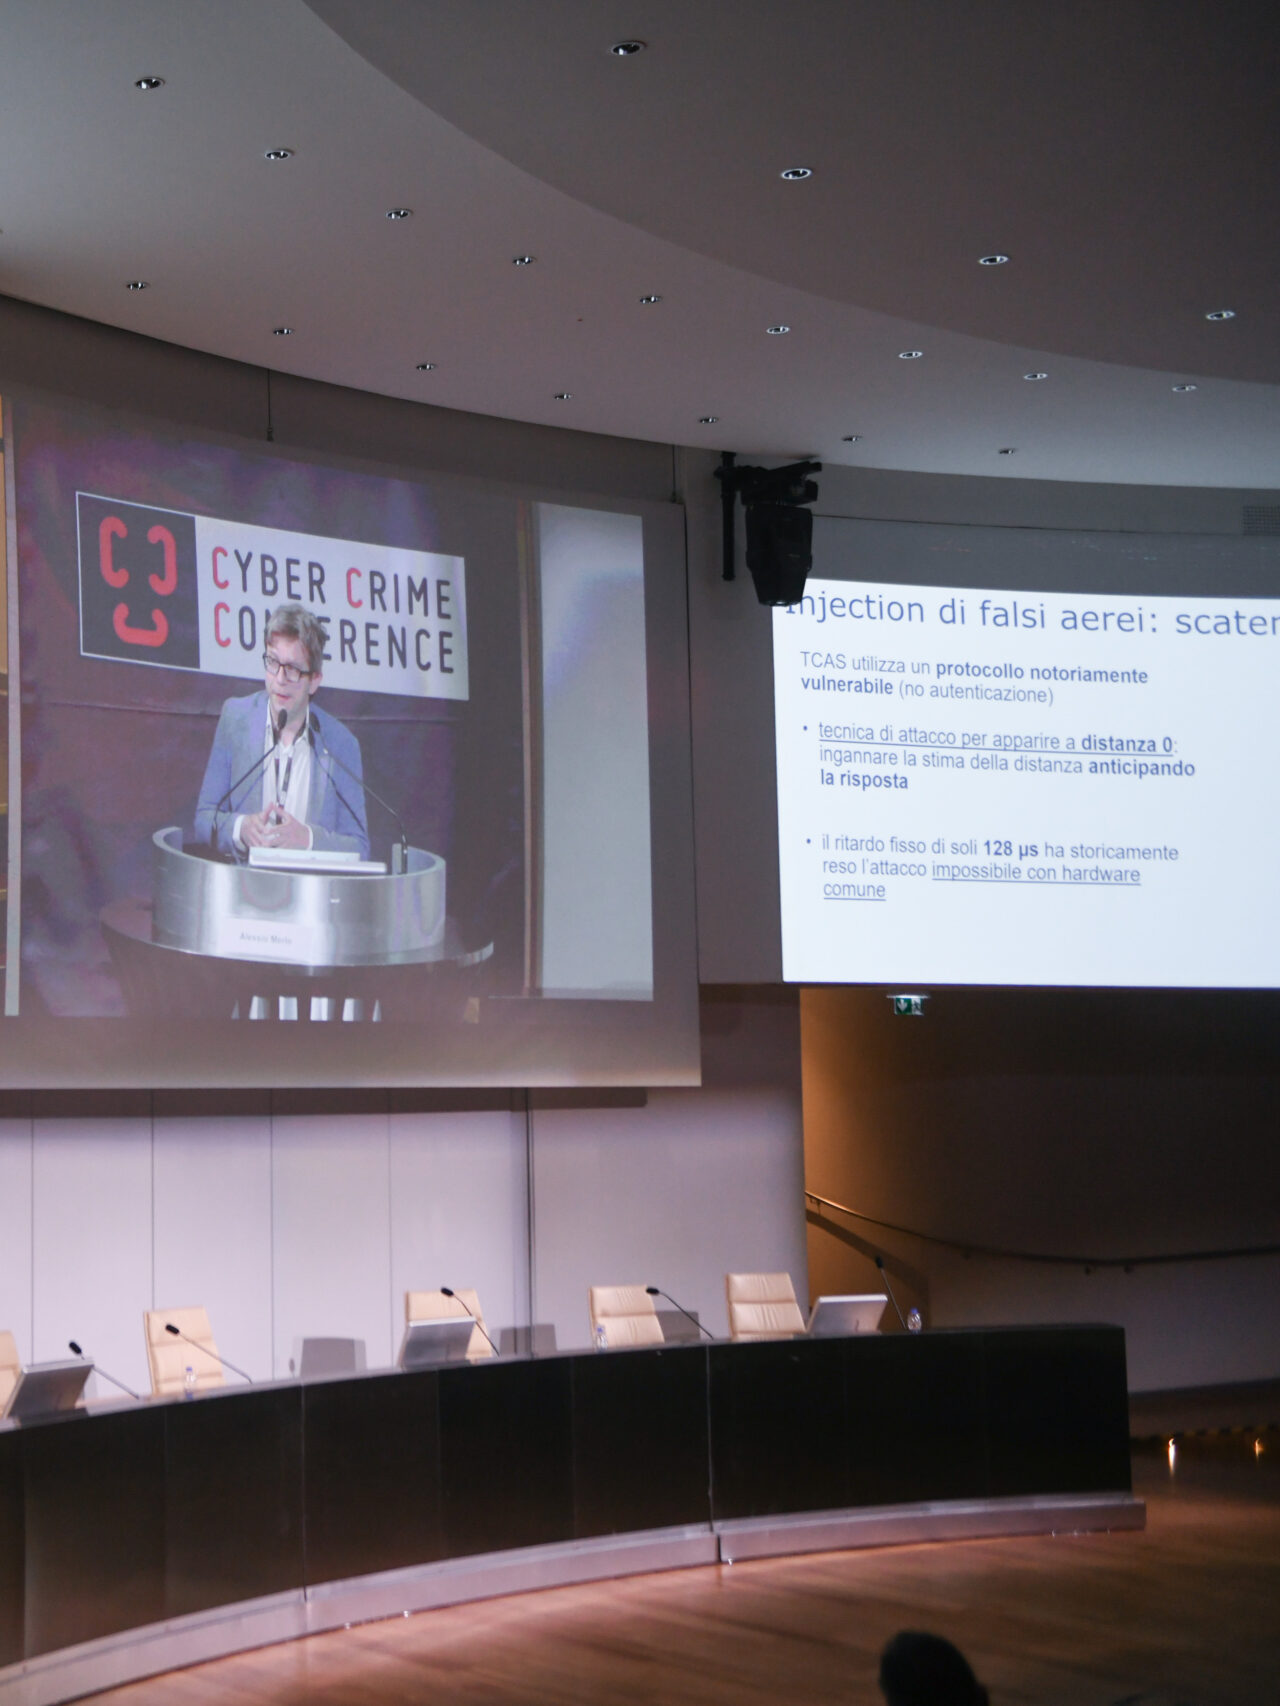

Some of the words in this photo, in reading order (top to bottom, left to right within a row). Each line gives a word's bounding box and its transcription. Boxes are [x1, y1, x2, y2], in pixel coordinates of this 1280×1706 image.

[212, 546, 326, 604] CYBER
[346, 567, 451, 620] CRIME
[939, 598, 965, 625] di
[980, 600, 1045, 628] falsi
[1061, 607, 1157, 633] aerei:
[800, 651, 847, 669] TCAS
[852, 656, 905, 673] utilizza
[911, 661, 930, 674] un
[936, 661, 1024, 679] protocollo
[1030, 666, 1148, 683] notoriamente
[801, 676, 893, 694] vulnerabile
[899, 680, 924, 699] (no
[930, 683, 1053, 706] autenticazione)
[819, 722, 874, 741] tecnica
[880, 725, 893, 741] di
[898, 728, 956, 745] attacco
[962, 730, 987, 748] per
[993, 733, 1060, 750] apparire
[1066, 738, 1075, 750] a
[1081, 735, 1156, 752] distanza
[820, 745, 897, 767] ingannare
[904, 750, 916, 766] la
[922, 752, 964, 769] stima
[970, 754, 1008, 770] della
[1014, 755, 1083, 773] distanza
[1089, 759, 1195, 779] anticipando
[821, 769, 834, 785] la
[840, 771, 908, 791] risposta
[822, 834, 829, 850] il
[836, 834, 884, 852] ritardo
[890, 836, 926, 854] fisso
[931, 839, 945, 854] di
[951, 839, 977, 855] soli
[984, 840, 1012, 856] 128
[1045, 842, 1064, 858] ha
[1070, 843, 1179, 861] storicamente
[823, 860, 856, 874] reso
[932, 861, 1021, 880] impossibile
[1027, 866, 1056, 880] con
[1063, 864, 1140, 882] hardware
[824, 882, 885, 897] comune
